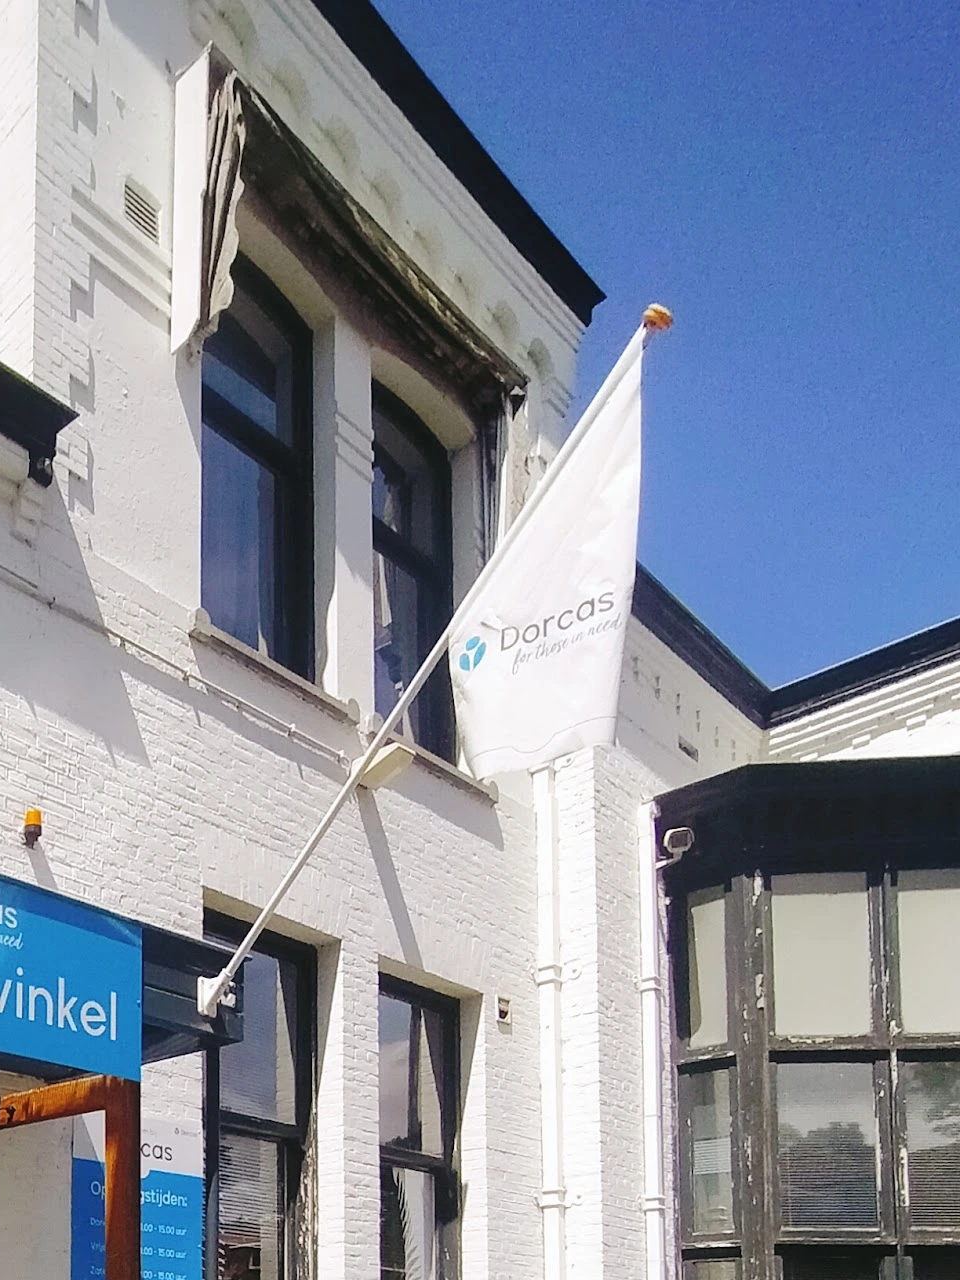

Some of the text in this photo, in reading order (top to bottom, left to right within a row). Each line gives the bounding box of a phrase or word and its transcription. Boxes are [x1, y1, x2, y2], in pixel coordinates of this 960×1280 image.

[500, 591, 615, 652] Dorcas
[511, 612, 623, 675] for those in need
[140, 1142, 173, 1162] cas
